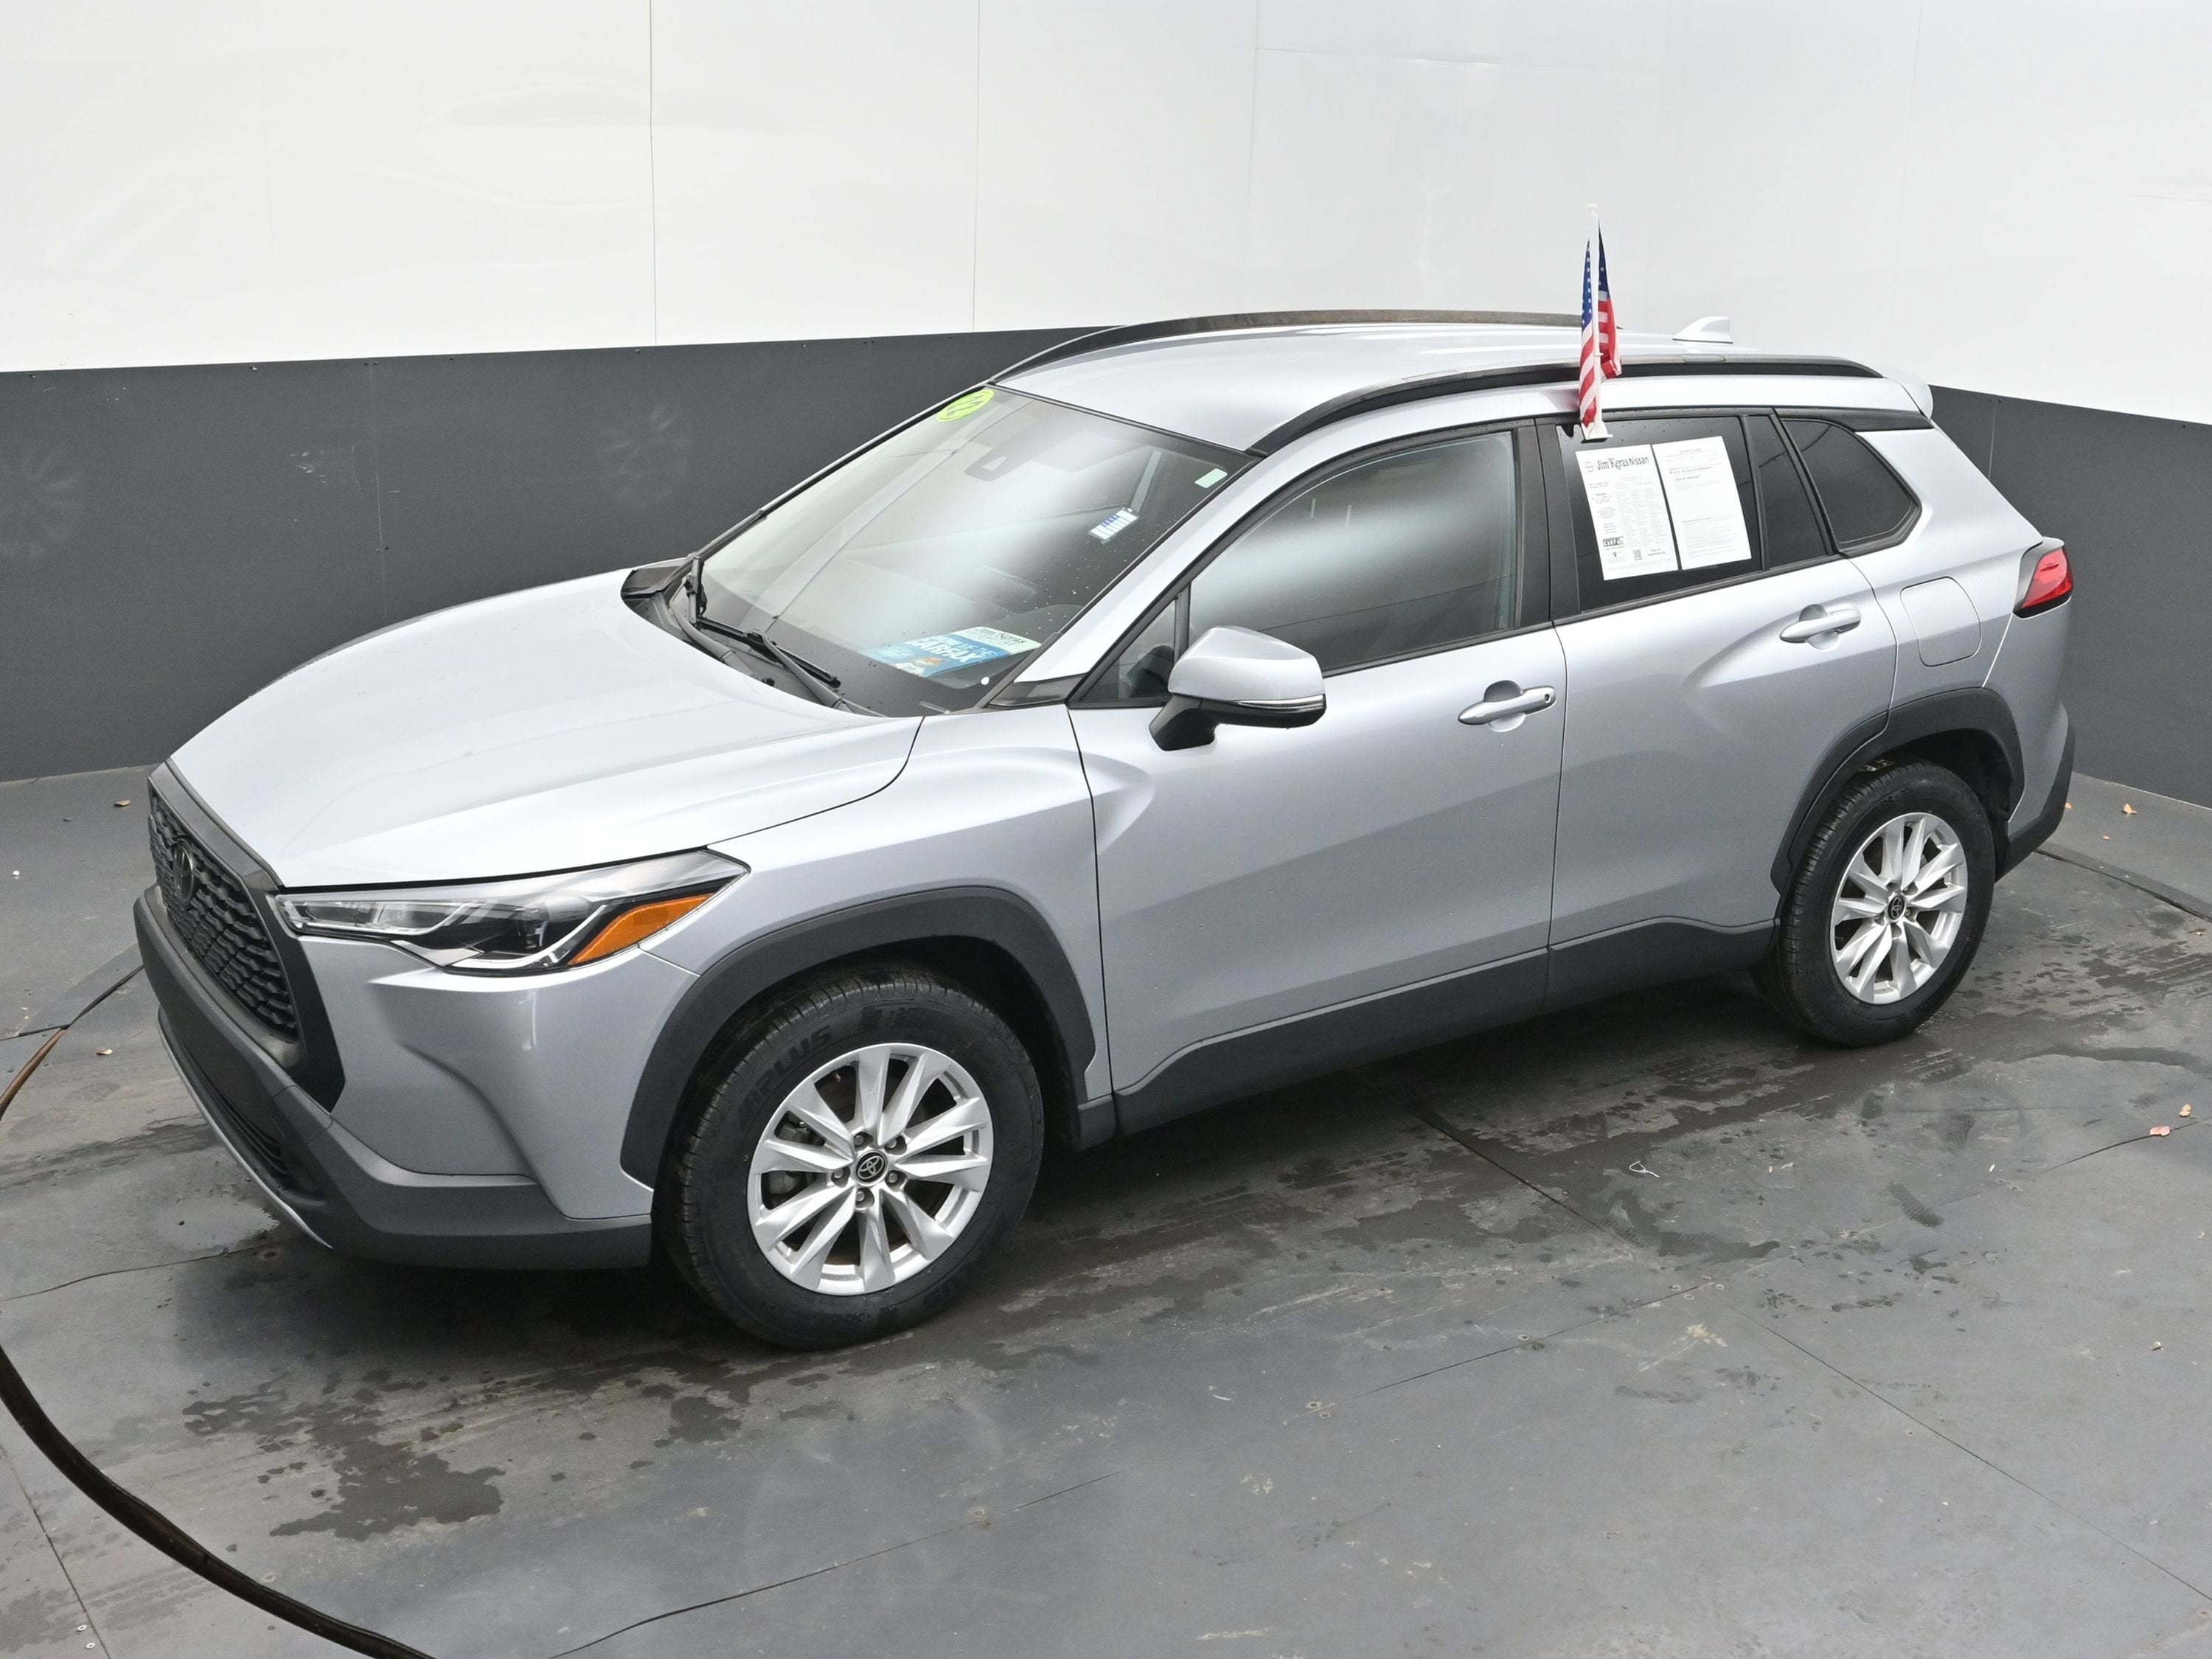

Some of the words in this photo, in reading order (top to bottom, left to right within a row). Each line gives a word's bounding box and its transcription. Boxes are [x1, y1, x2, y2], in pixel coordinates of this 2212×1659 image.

[1596, 459, 1610, 470] Jim
[1608, 457, 1630, 470] Keras
[1628, 456, 1650, 466] Nissan
[904, 639, 984, 664] CARFAX
